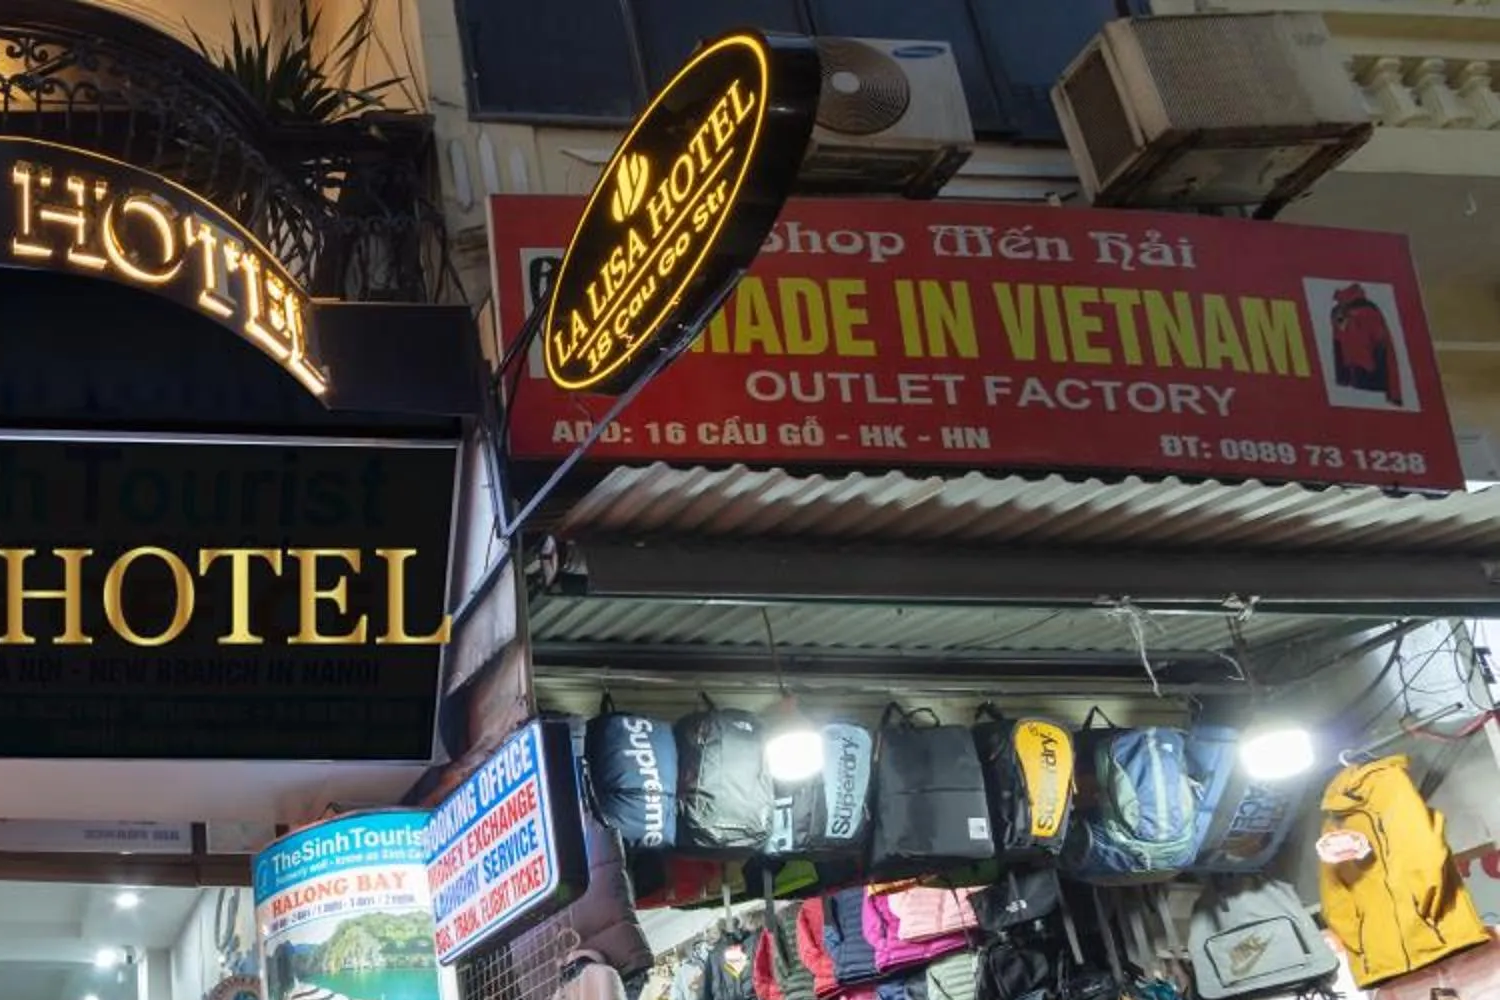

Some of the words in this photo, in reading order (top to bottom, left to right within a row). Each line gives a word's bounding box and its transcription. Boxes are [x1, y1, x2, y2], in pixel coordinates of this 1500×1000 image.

[554, 309, 589, 368] LA
[587, 228, 648, 321] LISA
[646, 80, 755, 238] HOTEL
[761, 221, 905, 263] Shop
[11, 162, 330, 396] HOTEL
[587, 334, 612, 373] 18
[895, 278, 981, 359] IN
[992, 281, 1312, 378] VIETNAM
[745, 371, 965, 406] OUTLET
[983, 375, 1238, 417] FACTORY
[552, 420, 634, 444] ADD:
[644, 421, 687, 445] 16
[860, 426, 907, 449] HK
[942, 426, 991, 450] HN
[1219, 437, 1298, 466] 0989
[1303, 444, 1344, 468] 73
[1351, 449, 1428, 475] 1238
[479, 734, 534, 805] OFFICE
[622, 718, 664, 847] Supreme
[831, 736, 860, 836] Superdry
[1036, 730, 1059, 831] Sdry
[467, 779, 538, 858] EXCHANGE
[271, 877, 349, 920] HALONG
[355, 870, 408, 892] BAY
[434, 864, 481, 923] LAUNDRY
[482, 819, 540, 884] SERVICE
[510, 855, 547, 907] TICKET
